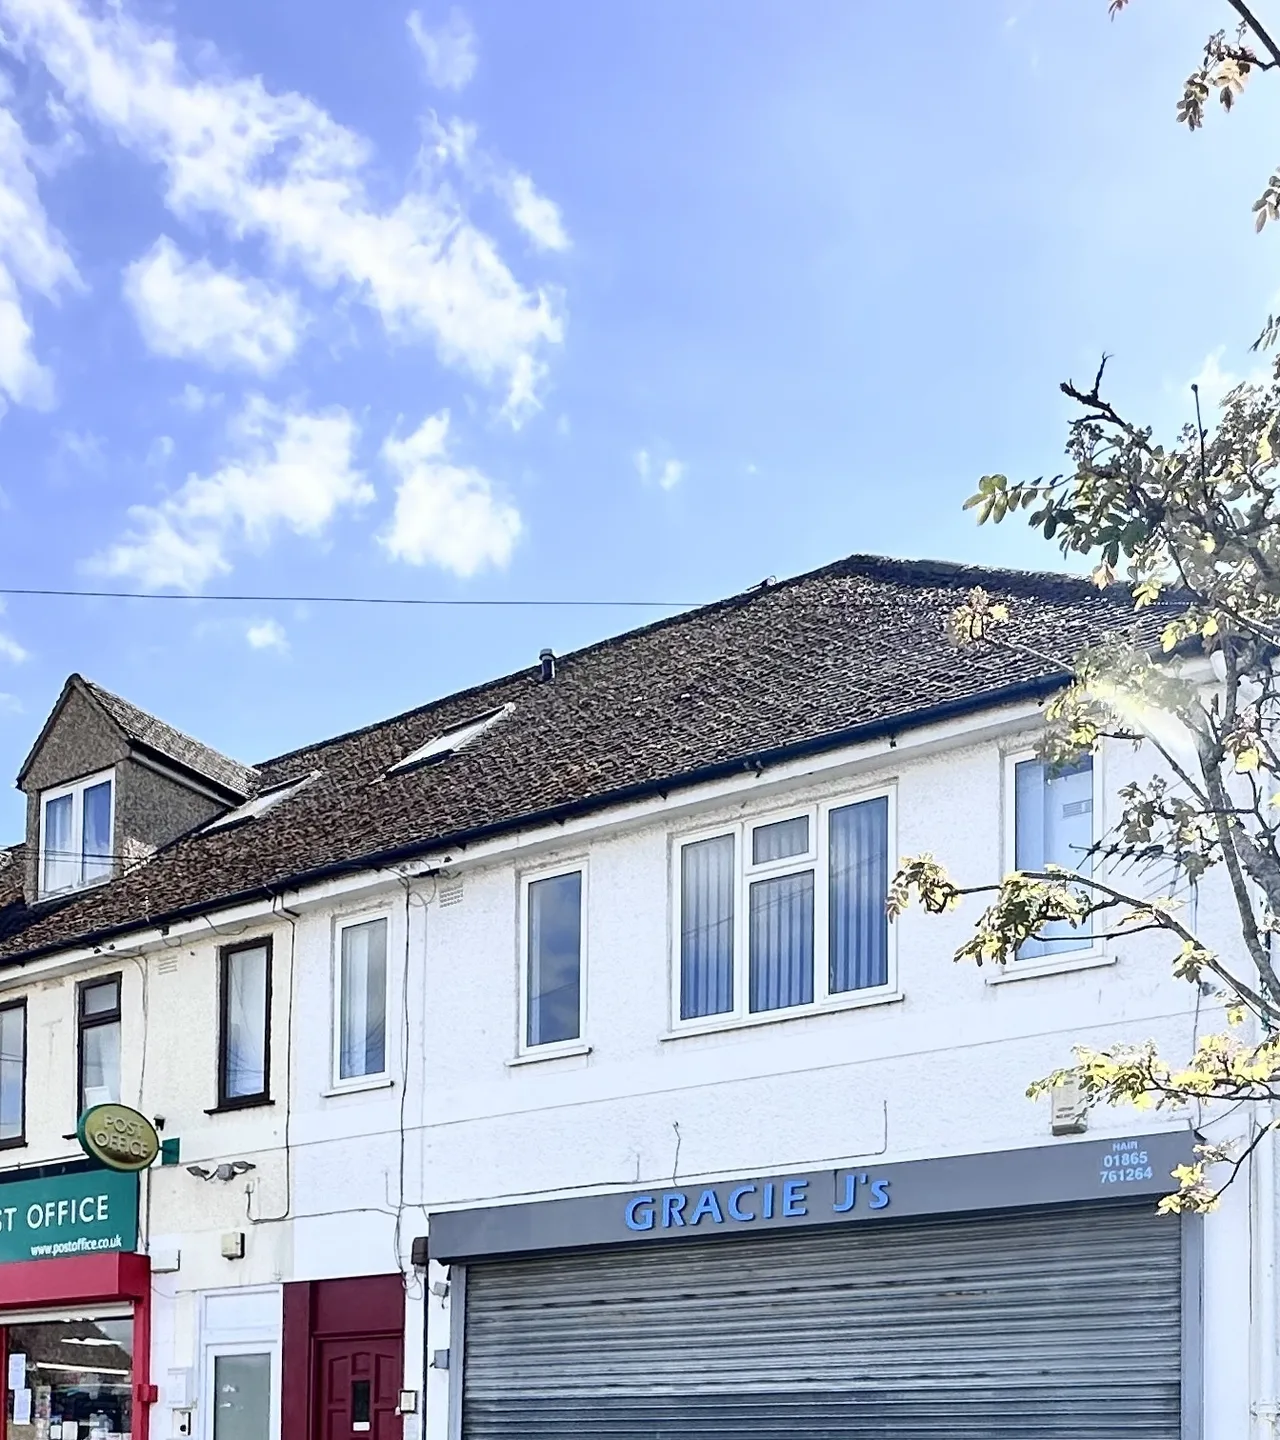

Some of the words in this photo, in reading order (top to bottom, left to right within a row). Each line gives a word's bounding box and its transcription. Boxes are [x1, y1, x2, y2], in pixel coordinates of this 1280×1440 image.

[103, 1114, 145, 1138] POST
[94, 1131, 150, 1159] OFFICE
[1103, 1151, 1148, 1168] 01865
[1100, 1166, 1153, 1184] 761264
[26, 1194, 110, 1230] OFFICE
[624, 1179, 809, 1232] GRACIE
[832, 1173, 891, 1212] J's
[30, 1234, 122, 1257] www.postoffice.co.uk
